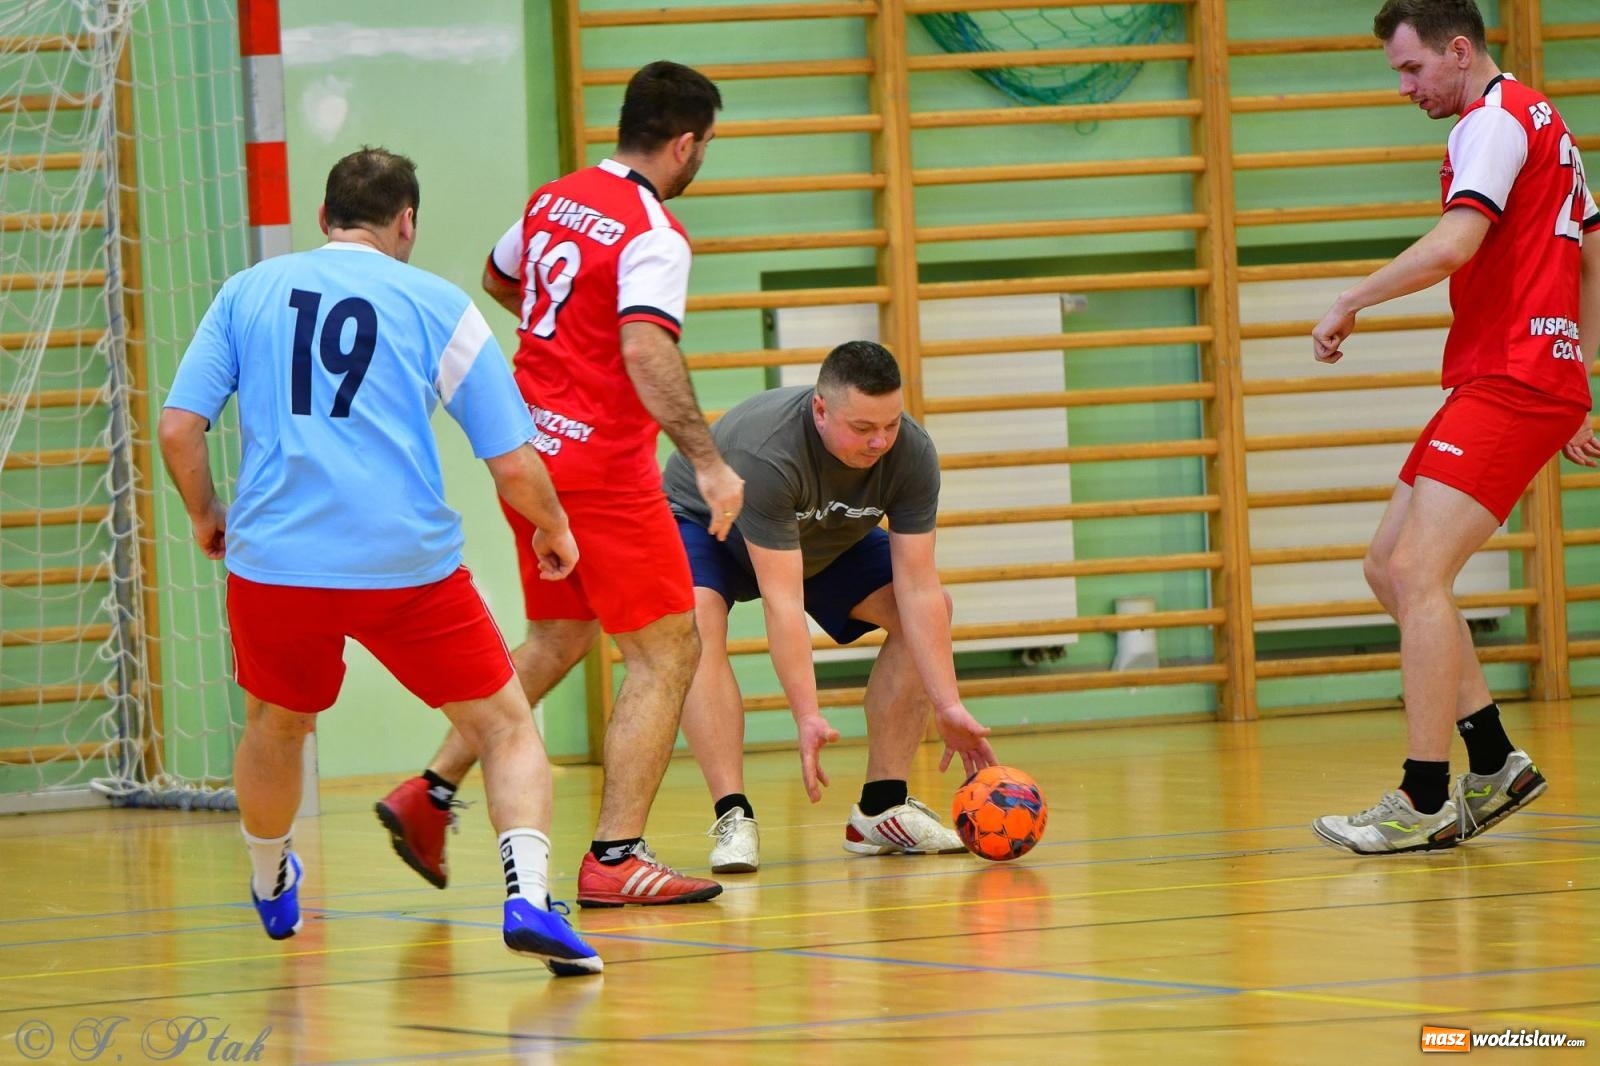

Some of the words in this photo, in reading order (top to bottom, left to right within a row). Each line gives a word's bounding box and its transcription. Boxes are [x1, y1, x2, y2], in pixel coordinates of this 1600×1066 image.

[1528, 101, 1553, 131] AP
[519, 230, 582, 340] 19
[288, 287, 378, 418] 19
